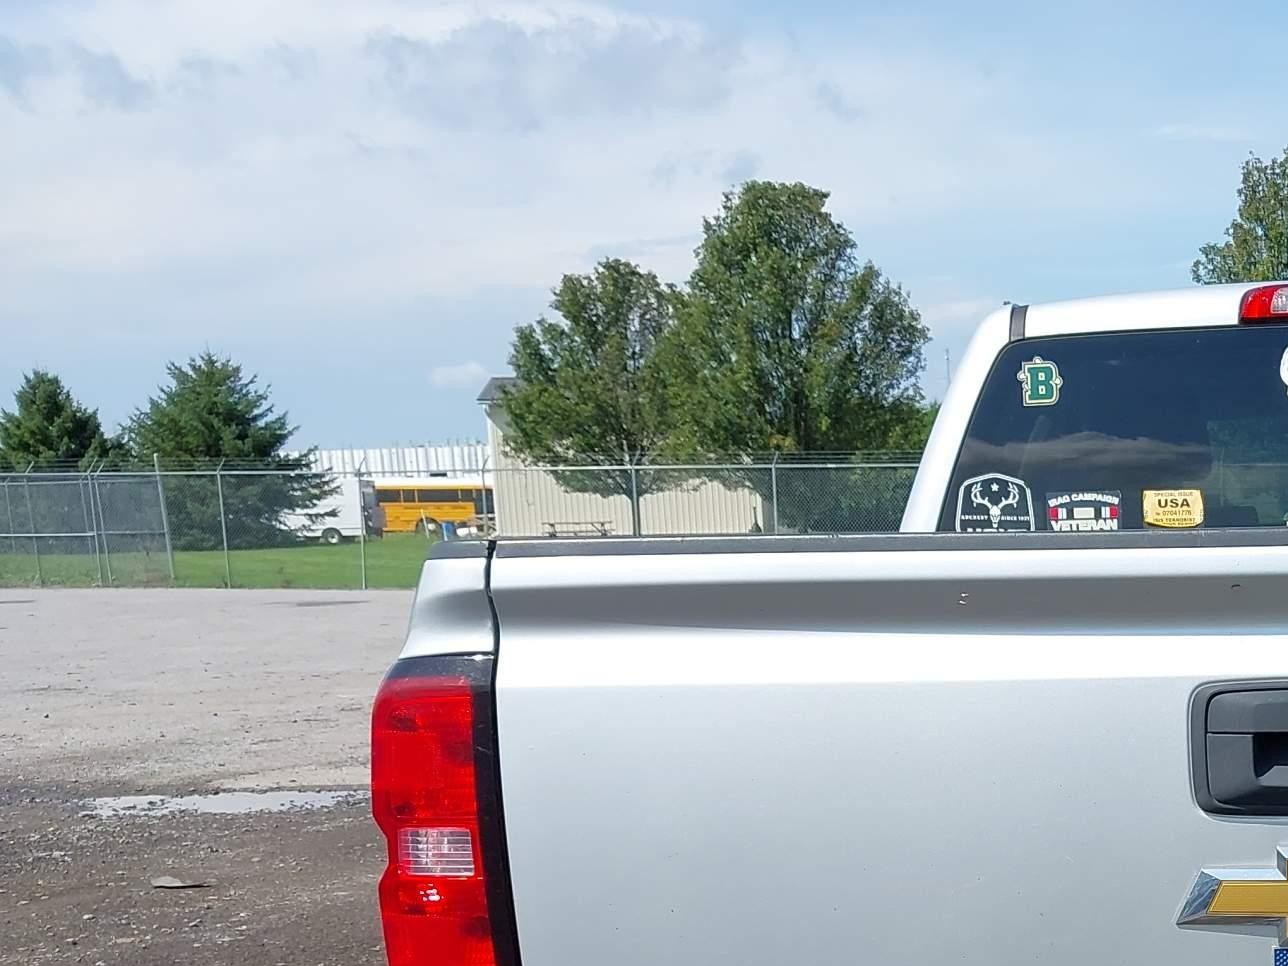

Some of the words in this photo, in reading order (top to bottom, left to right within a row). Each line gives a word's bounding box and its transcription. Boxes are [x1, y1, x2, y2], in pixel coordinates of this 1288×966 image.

[1024, 362, 1058, 405] B
[1048, 494, 1070, 507] IRAQ
[1071, 493, 1119, 505] CAMPAIGN
[1158, 498, 1191, 509] USA
[1050, 518, 1118, 532] VETERAN
